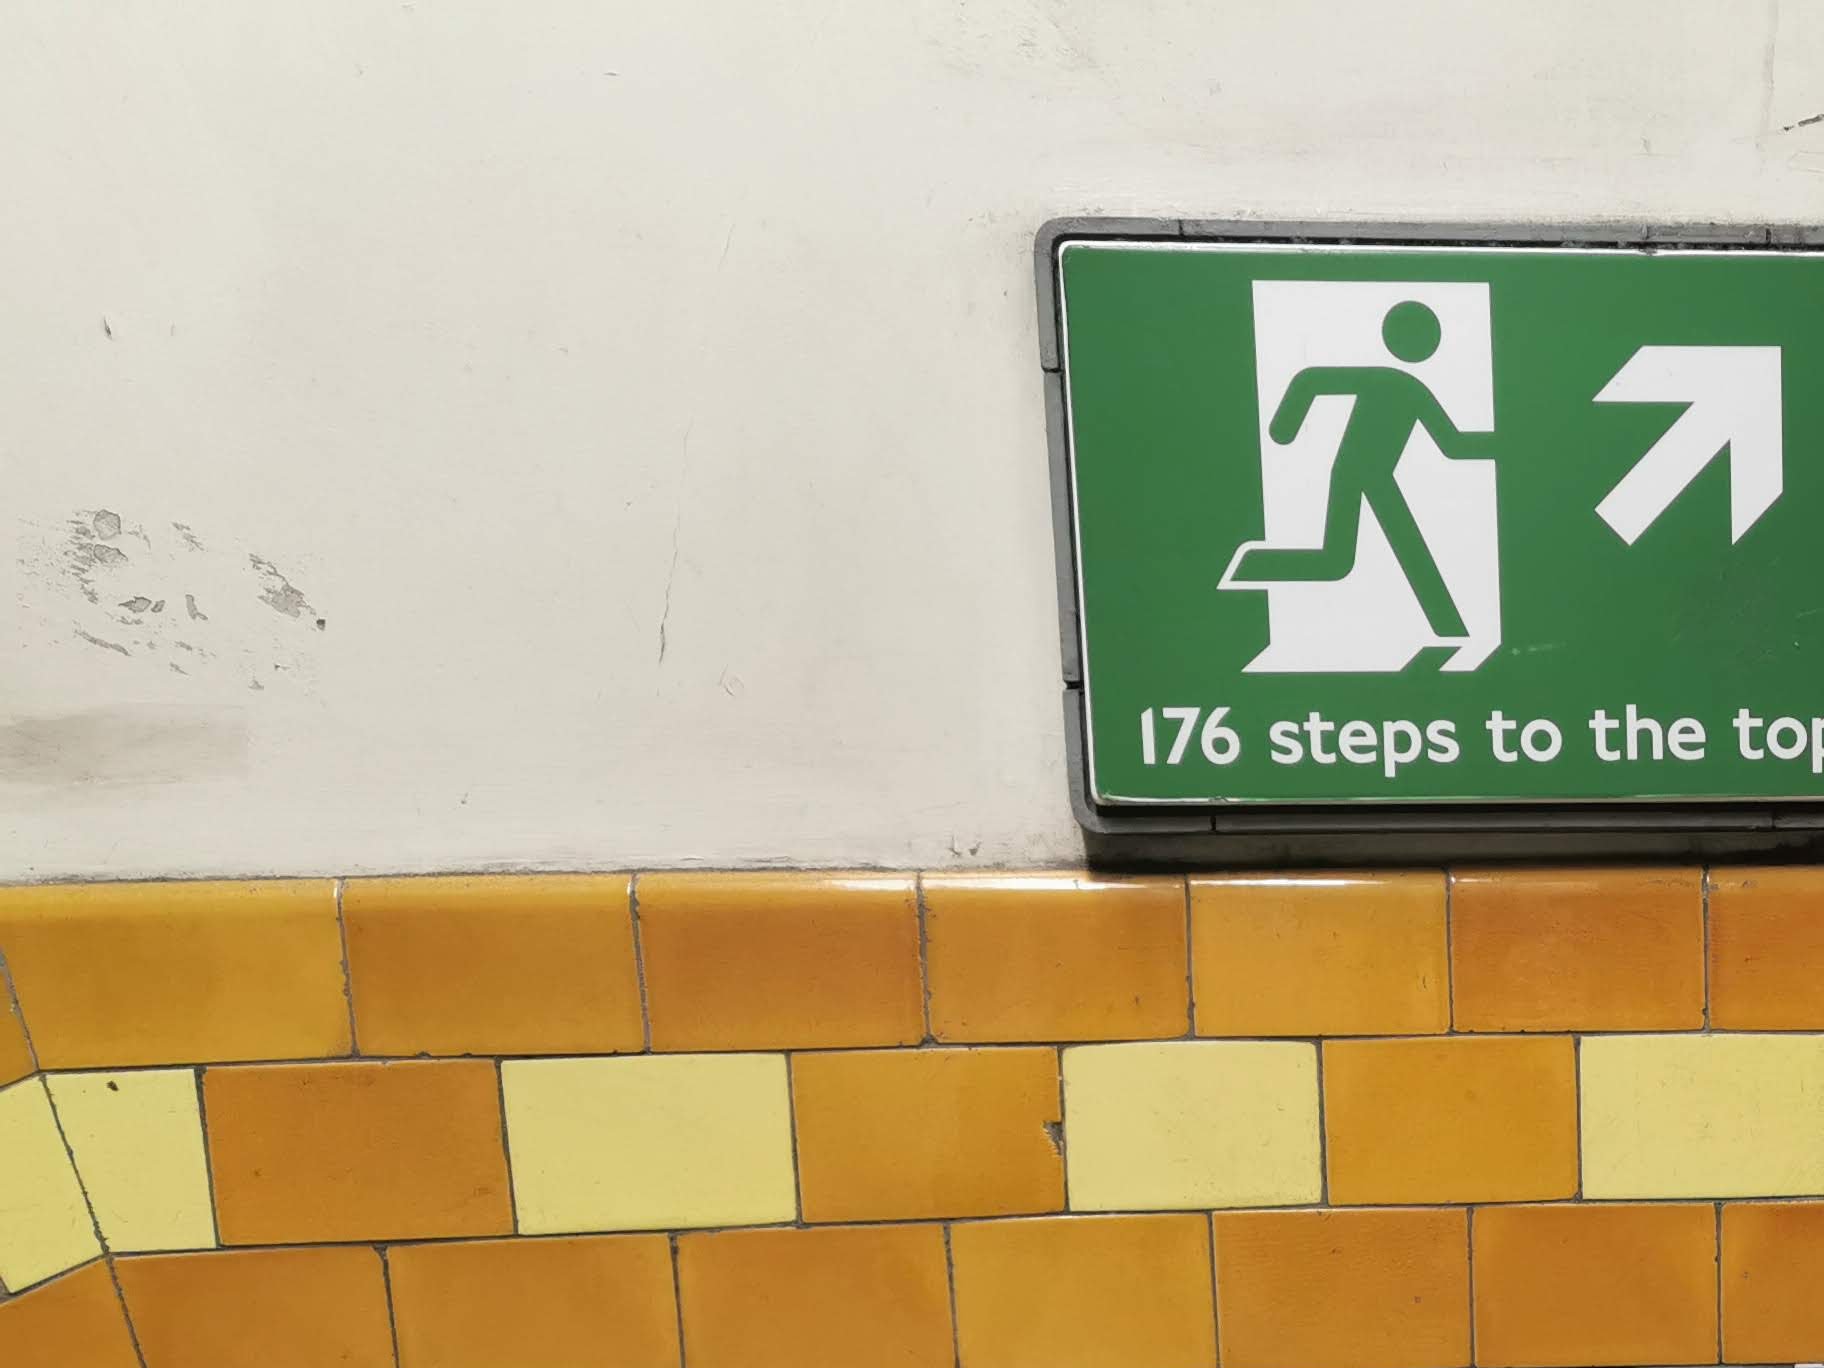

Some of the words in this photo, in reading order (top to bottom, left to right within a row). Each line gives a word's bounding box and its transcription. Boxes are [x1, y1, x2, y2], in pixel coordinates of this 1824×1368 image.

[1138, 704, 1243, 767] 176
[1268, 709, 1462, 780] steps
[1484, 708, 1565, 765] to
[1586, 701, 1708, 764] the
